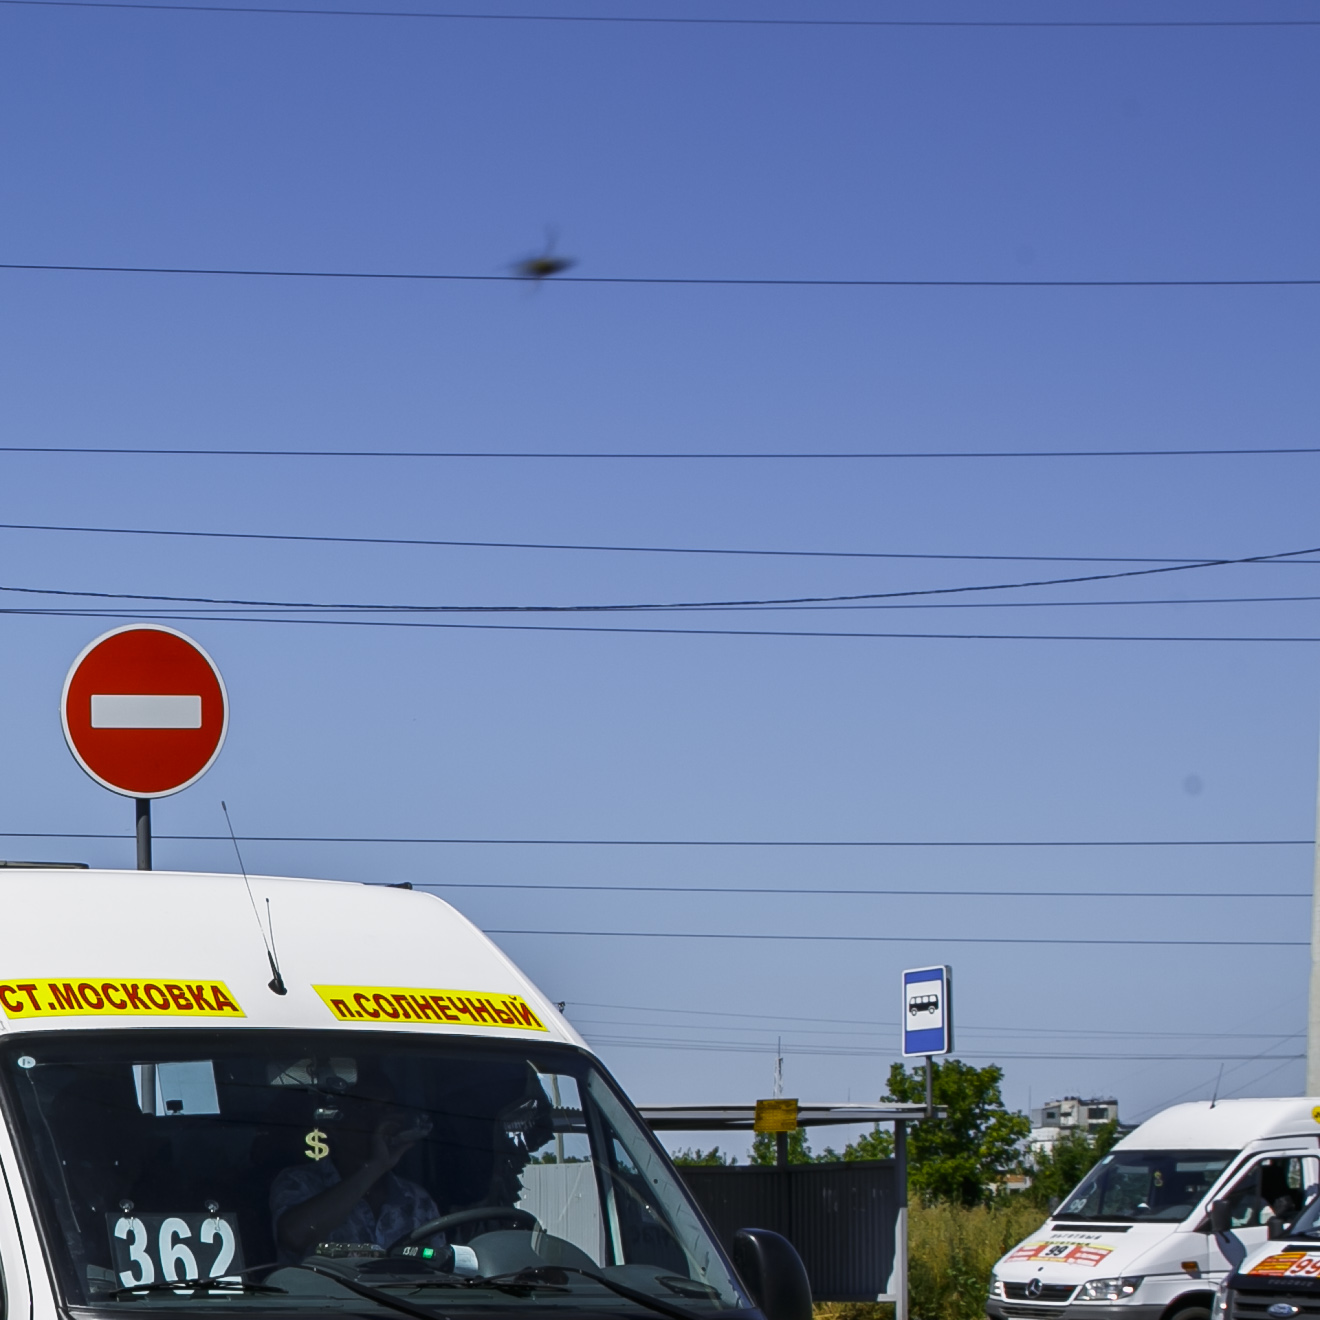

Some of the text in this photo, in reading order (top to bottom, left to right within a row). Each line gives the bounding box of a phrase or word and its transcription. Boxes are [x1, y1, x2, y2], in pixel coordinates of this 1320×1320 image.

[333, 992, 543, 1029] п.СОЛНЕЧНЫЙ
[114, 1217, 244, 1295] 362
[1044, 1245, 1069, 1256] 99
